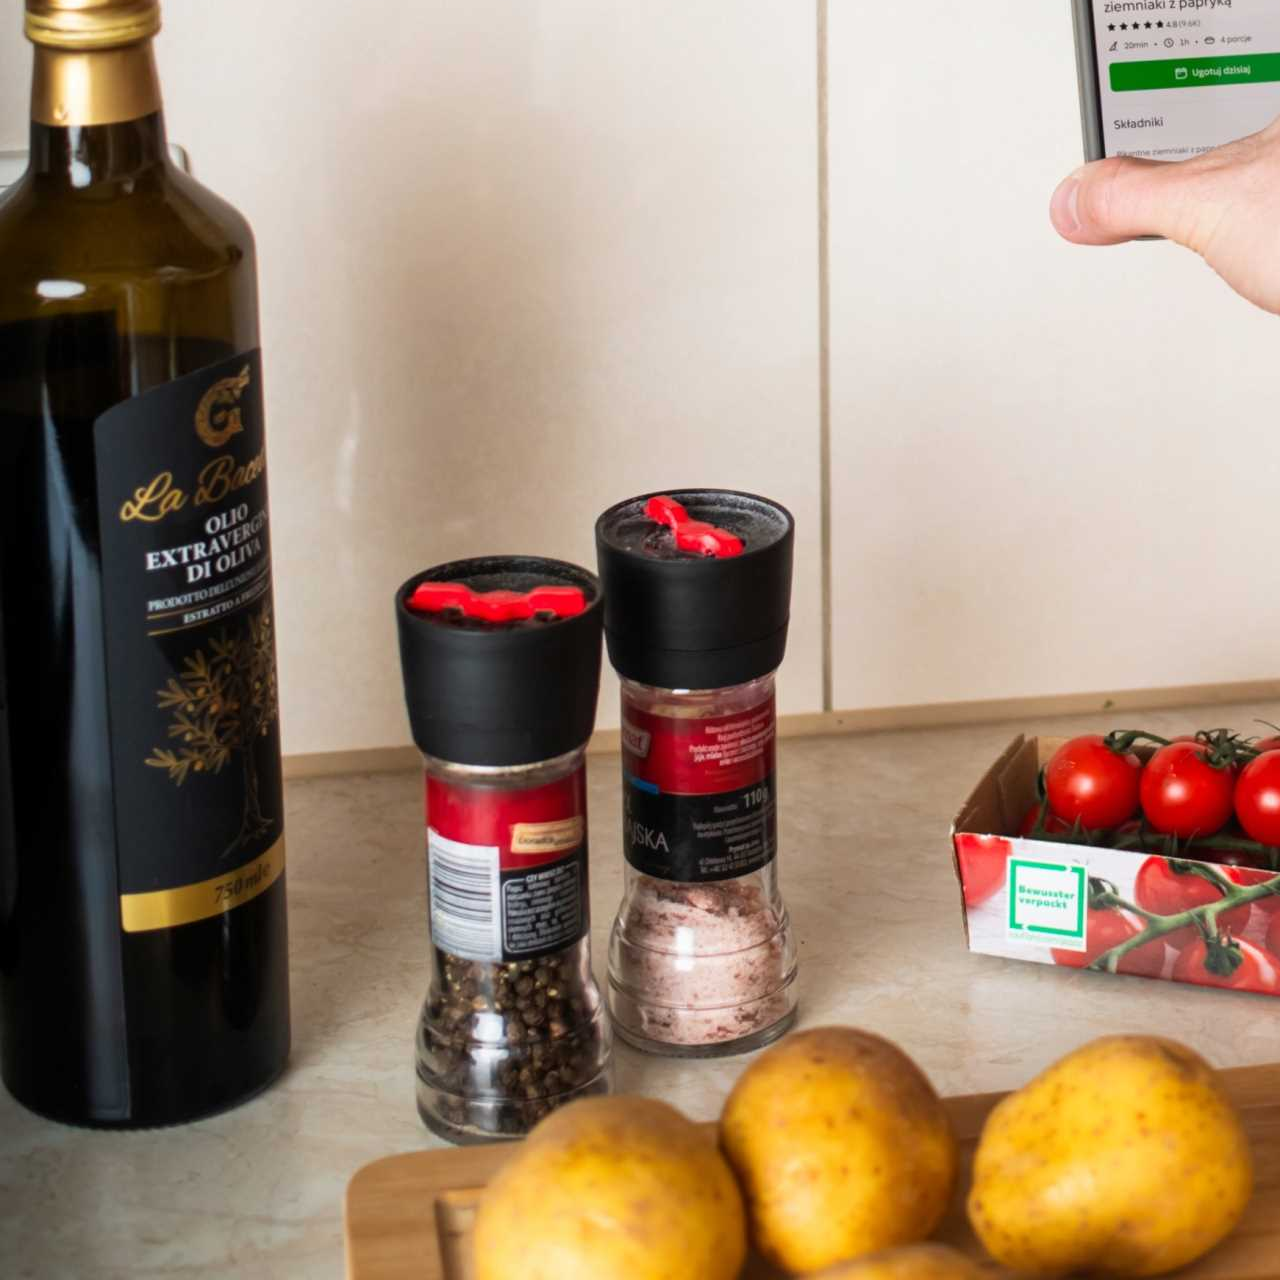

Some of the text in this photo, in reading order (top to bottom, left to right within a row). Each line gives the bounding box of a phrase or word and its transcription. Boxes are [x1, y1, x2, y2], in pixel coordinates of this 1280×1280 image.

[1169, 1, 1176, 10] z
[1227, 35, 1252, 44] porcje
[1192, 65, 1251, 78] Ugotuj dzisiaj
[1113, 116, 1164, 130] Składniki
[120, 471, 187, 522] La
[205, 503, 249, 535] OLIO
[145, 509, 268, 570] EXTRAVERGIN
[187, 537, 261, 584] DI OLIVA
[147, 588, 208, 612] PRODOTTO
[183, 599, 234, 624] ESTRATTO
[215, 879, 242, 903] 750
[1019, 885, 1075, 899] Bewusster
[1019, 897, 1067, 909] verpackt
